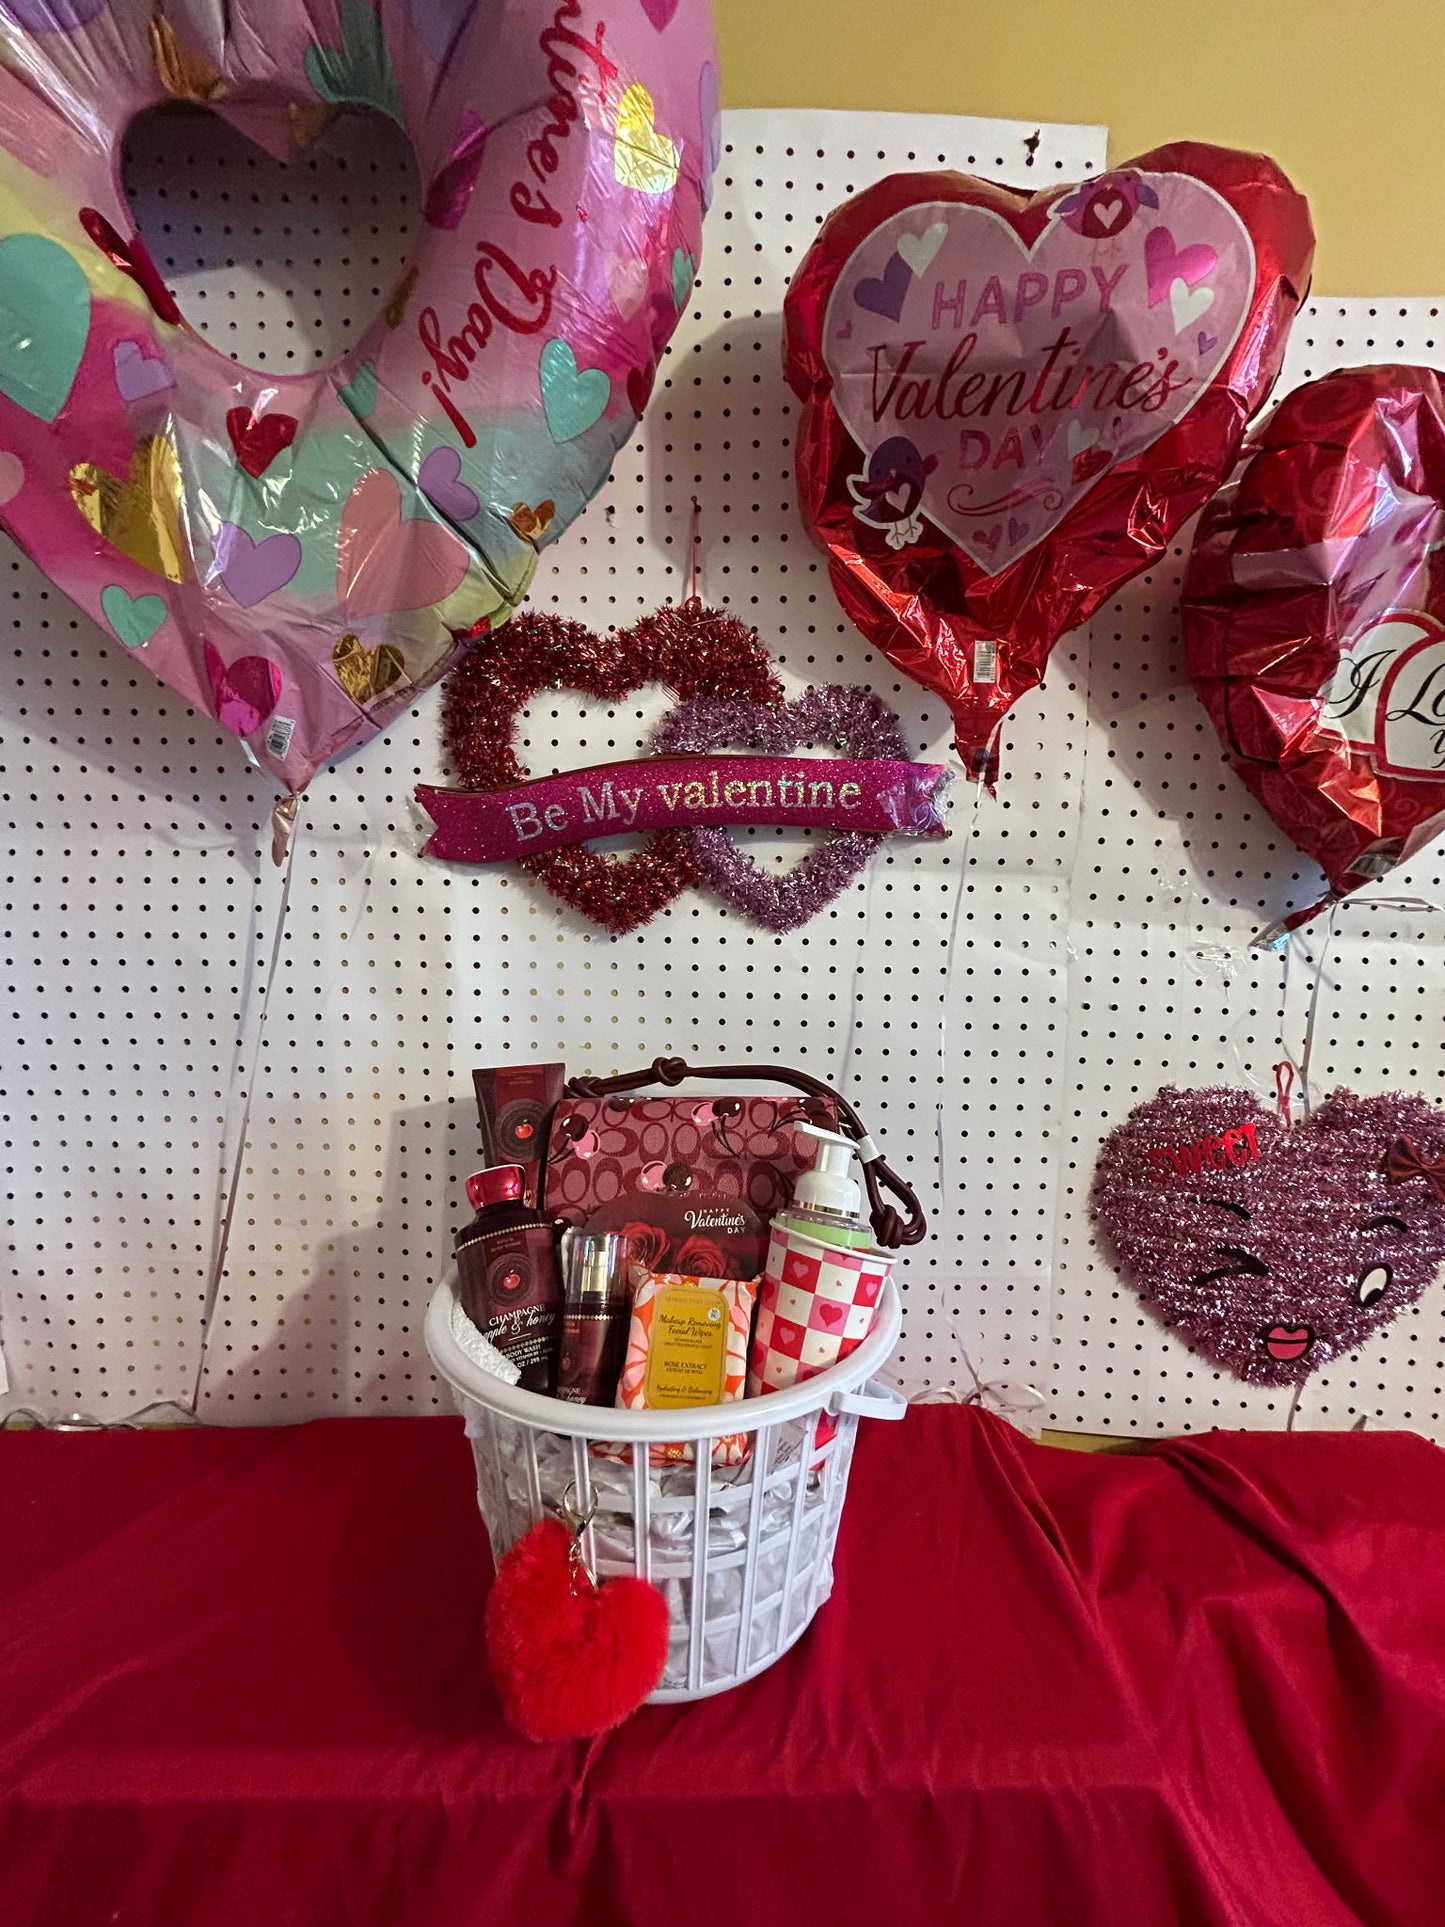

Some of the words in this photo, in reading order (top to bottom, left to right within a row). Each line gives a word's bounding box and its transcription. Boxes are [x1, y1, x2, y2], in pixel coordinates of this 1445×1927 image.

[931, 262, 1131, 330] HAPPY
[418, 241, 557, 449] Day!
[866, 326, 1194, 424] Valentine's
[957, 423, 1066, 473] DAY
[504, 801, 568, 843] Be
[576, 780, 645, 825] My
[656, 771, 862, 812] valentine
[684, 1209, 746, 1230] Valentine's
[727, 1226, 746, 1234] DAY
[489, 1303, 546, 1327] CHAMPAGNE
